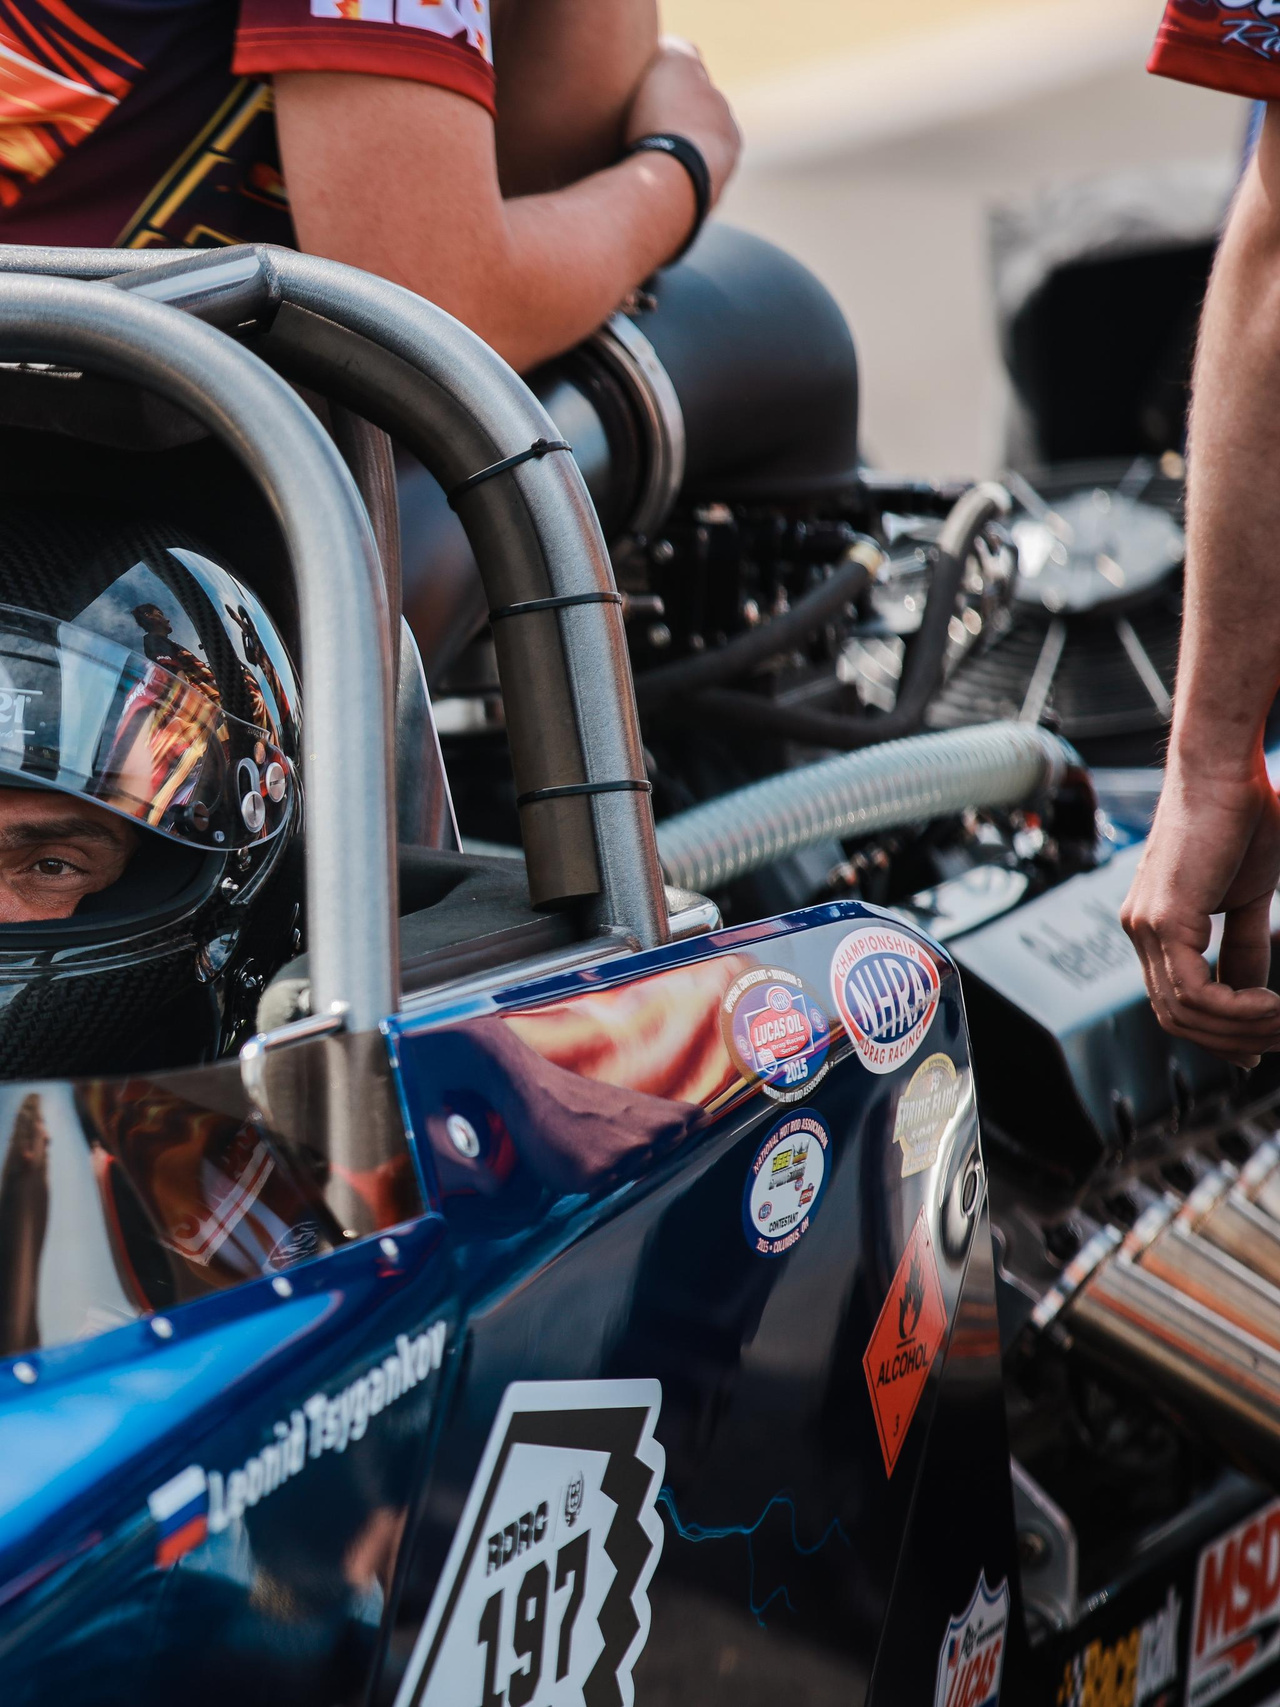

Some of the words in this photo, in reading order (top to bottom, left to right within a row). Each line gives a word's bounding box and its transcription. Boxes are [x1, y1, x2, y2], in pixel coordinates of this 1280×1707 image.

[836, 935, 916, 977] CHAMPIONSHIP
[848, 958, 927, 1038] NHRA
[754, 1017, 786, 1047] LUCAS
[785, 1013, 805, 1035] OIL
[863, 1040, 885, 1065] DRAG
[888, 1024, 923, 1064] RACING
[785, 1057, 809, 1084] 2015
[753, 1132, 779, 1175] NATIONAL
[769, 1212, 799, 1233] CONTESTANT
[876, 1343, 930, 1388] ALCOHOL
[208, 1410, 307, 1533] Leonid
[304, 1319, 447, 1459] Tsygankov
[893, 1414, 901, 1437] 3
[475, 1528, 592, 1707] 197
